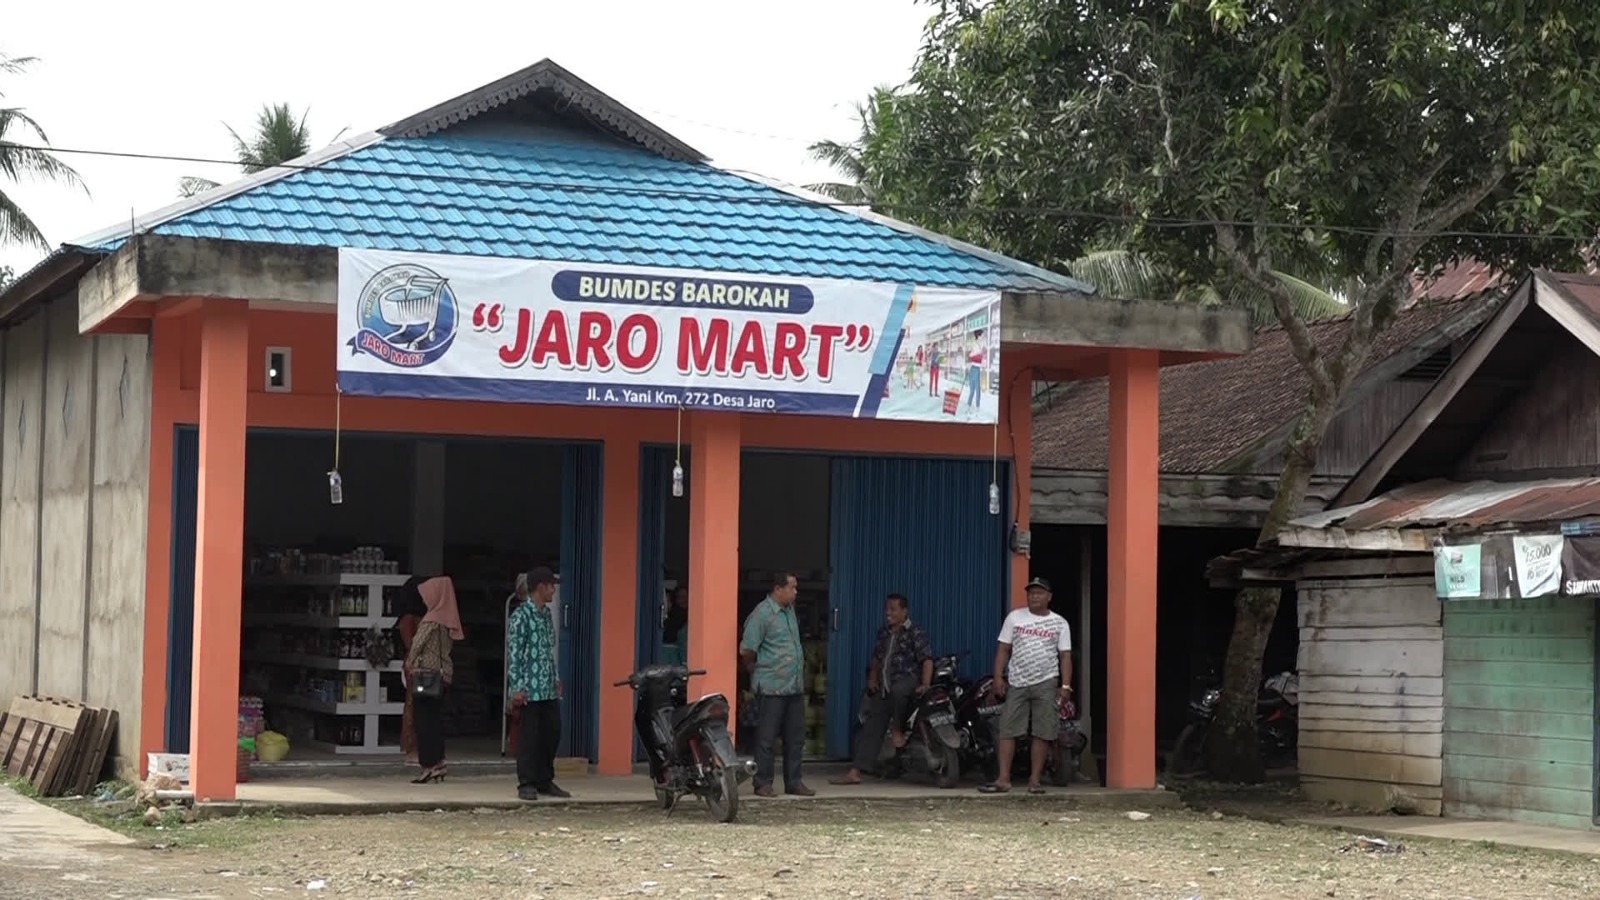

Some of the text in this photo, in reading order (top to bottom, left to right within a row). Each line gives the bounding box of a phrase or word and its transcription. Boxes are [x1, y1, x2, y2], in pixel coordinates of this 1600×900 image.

[579, 276, 790, 309] BUMDES BAROKAH
[362, 332, 425, 366] JARO MART
[586, 388, 601, 402] Jl.
[604, 388, 619, 403] A.
[623, 389, 652, 404] Yani
[685, 392, 710, 406] 272
[713, 393, 745, 409] Desa
[748, 395, 776, 410] Jaro
